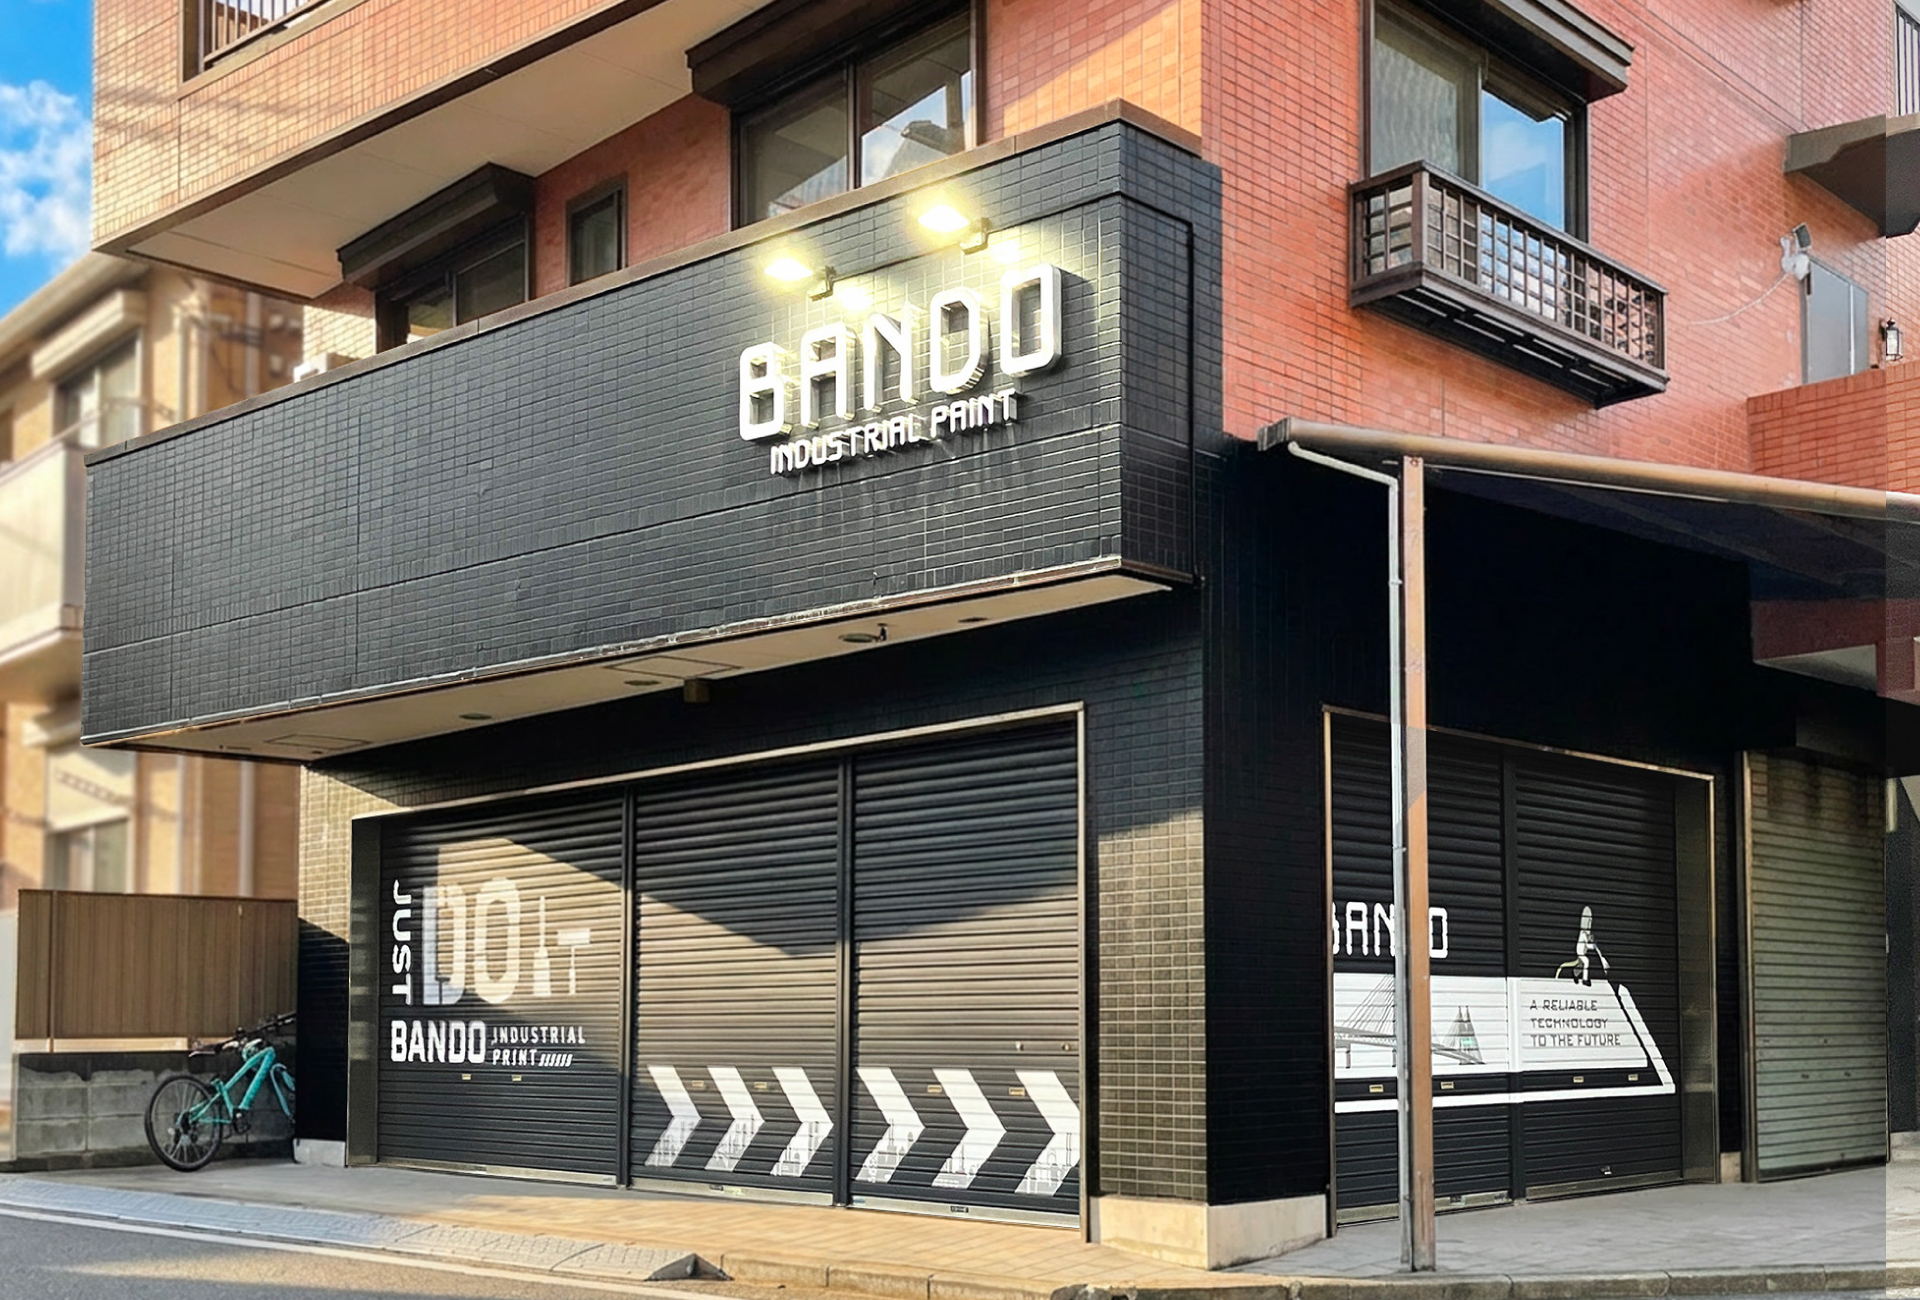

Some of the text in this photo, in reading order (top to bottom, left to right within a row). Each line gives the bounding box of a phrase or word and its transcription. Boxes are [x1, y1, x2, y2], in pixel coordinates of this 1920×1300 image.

[740, 263, 1063, 441] BANDO
[770, 388, 1017, 475] INDUSTRIAL PAINT
[392, 879, 412, 1006] JUST
[423, 877, 521, 1006] DO
[1530, 1000, 1598, 1011] A RELIABLE
[1530, 1018, 1609, 1029] TECHNOLOGY
[391, 1020, 486, 1063] BANDO
[491, 1026, 586, 1045] INDUSTRIAL
[1530, 1034, 1621, 1047] TO THE FUTURE
